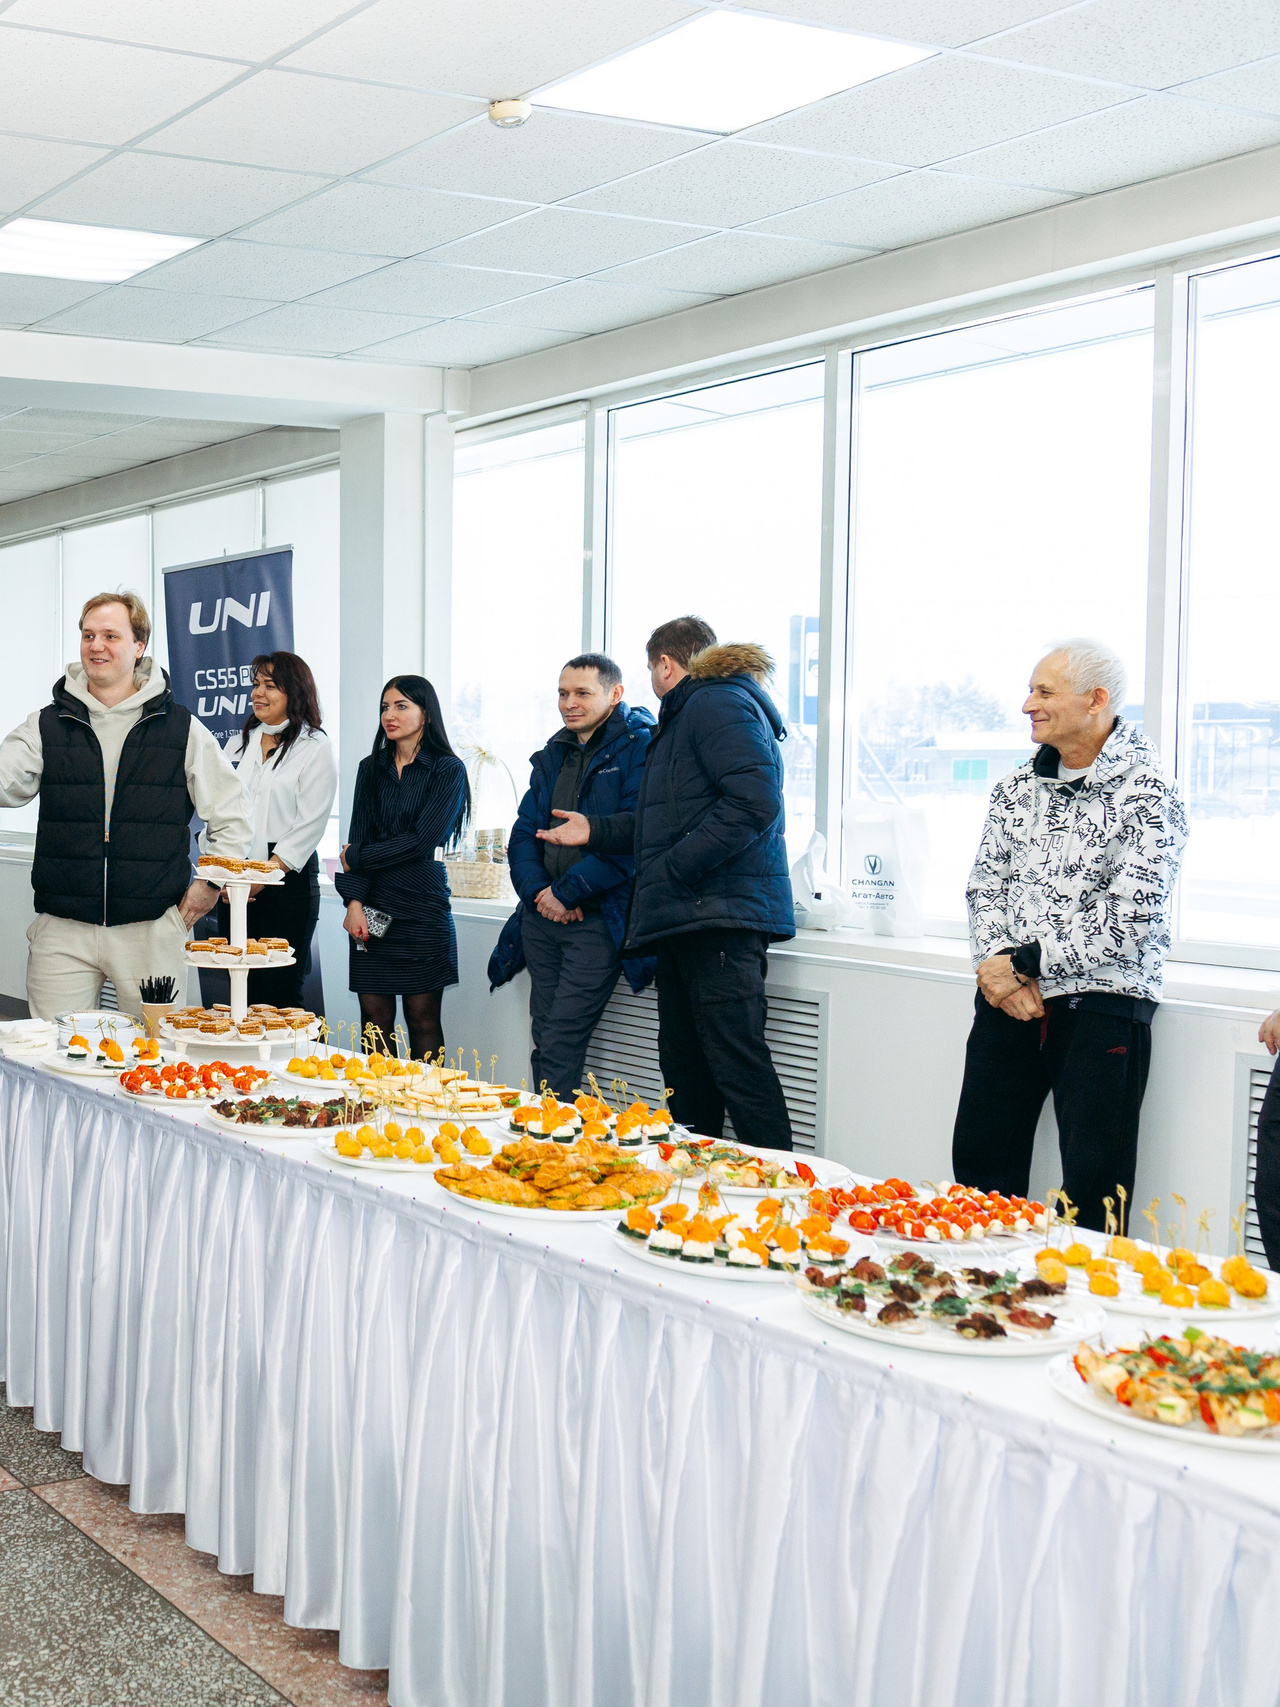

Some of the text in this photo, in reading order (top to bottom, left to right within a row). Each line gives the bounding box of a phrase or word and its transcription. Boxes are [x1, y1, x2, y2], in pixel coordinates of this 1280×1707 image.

[189, 590, 270, 635] UNI
[195, 667, 238, 691] CS55
[197, 694, 253, 717] UNI-
[851, 879, 895, 887] CHANGAN
[851, 891, 895, 901] Агат-Авто
